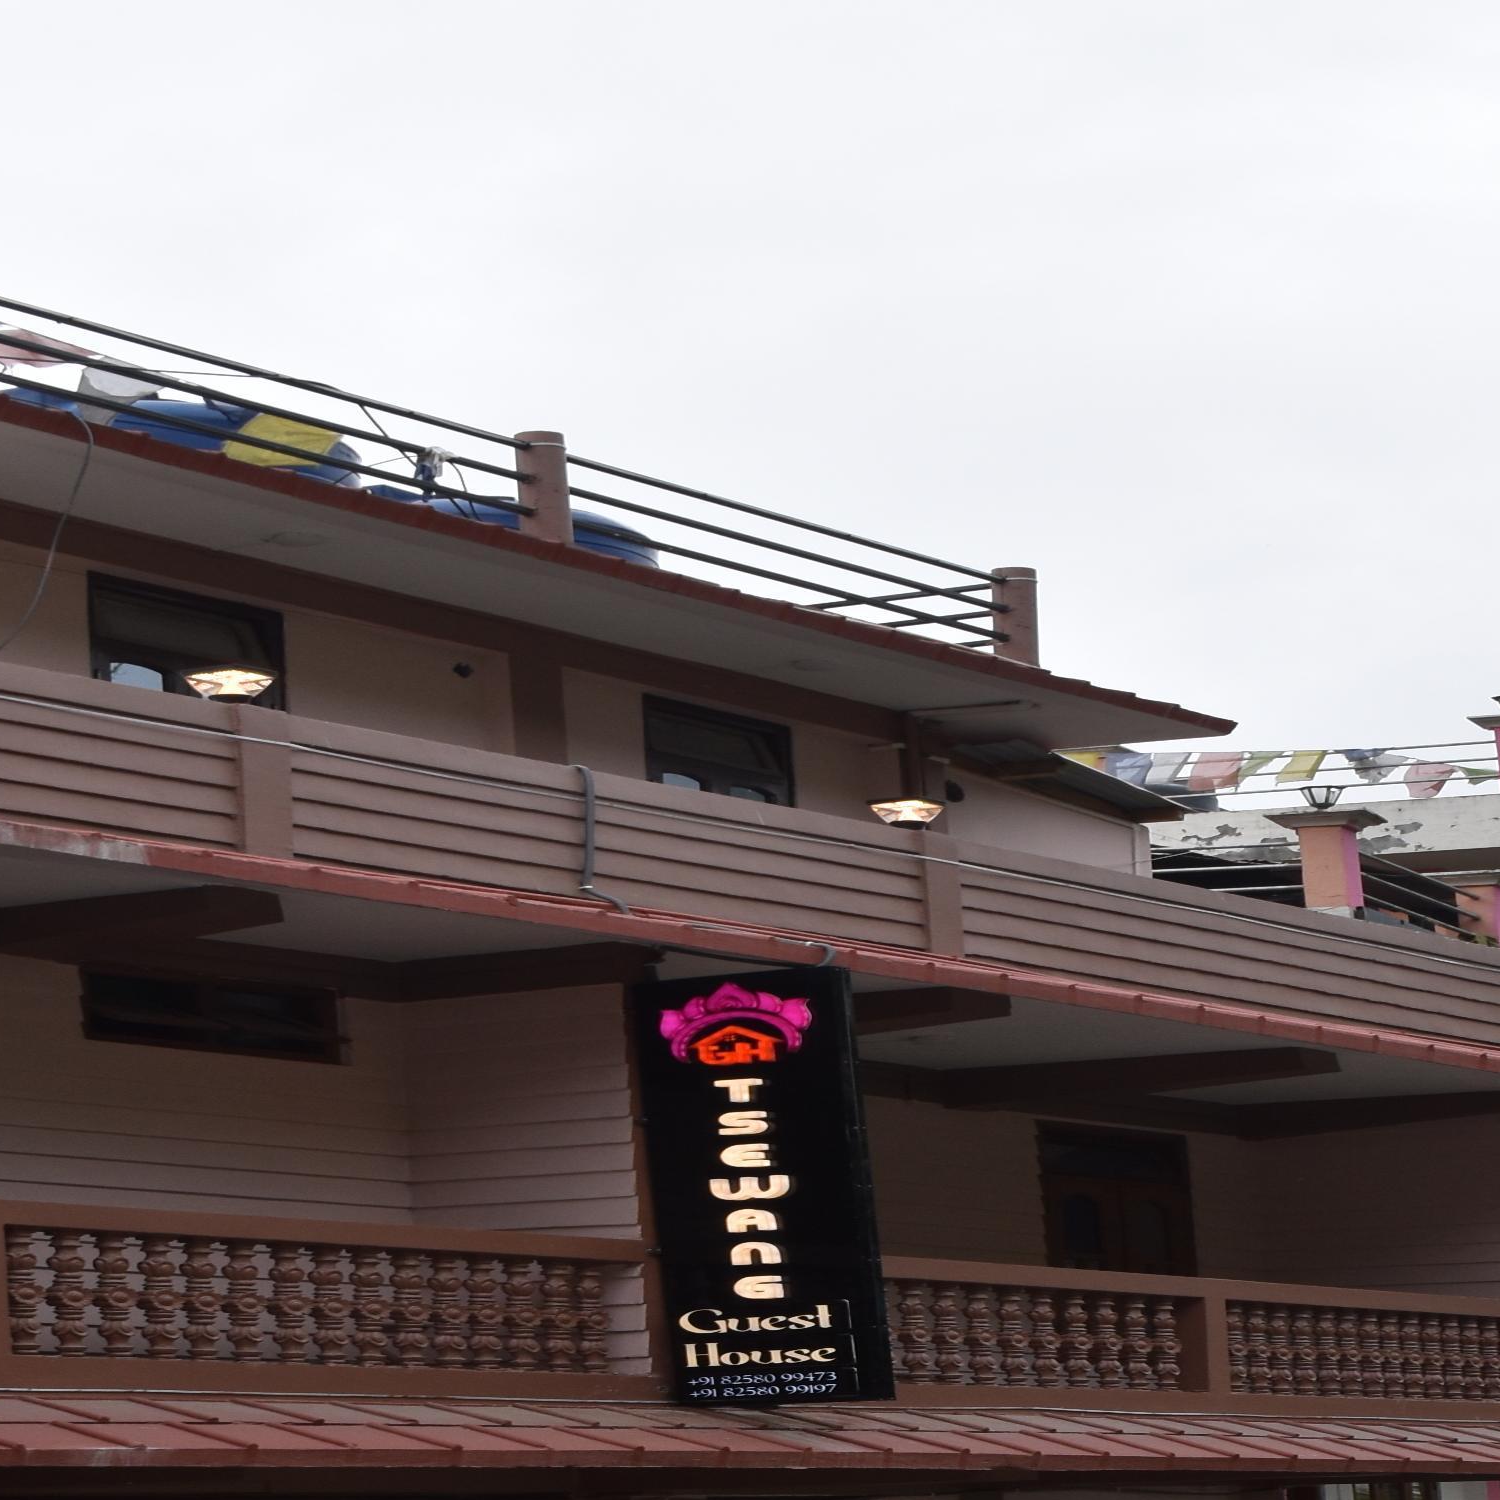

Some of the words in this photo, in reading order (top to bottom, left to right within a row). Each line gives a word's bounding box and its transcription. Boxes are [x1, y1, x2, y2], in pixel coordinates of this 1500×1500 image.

[708, 1077, 791, 1300] TSEWANG
[678, 1303, 833, 1335] Guest
[684, 1342, 837, 1368] House
[687, 1376, 715, 1386] +91
[720, 1373, 776, 1385] 82580
[780, 1371, 837, 1382] 99473
[689, 1388, 717, 1398] +91
[723, 1385, 780, 1397] 82580
[785, 1383, 837, 1395] 99197
